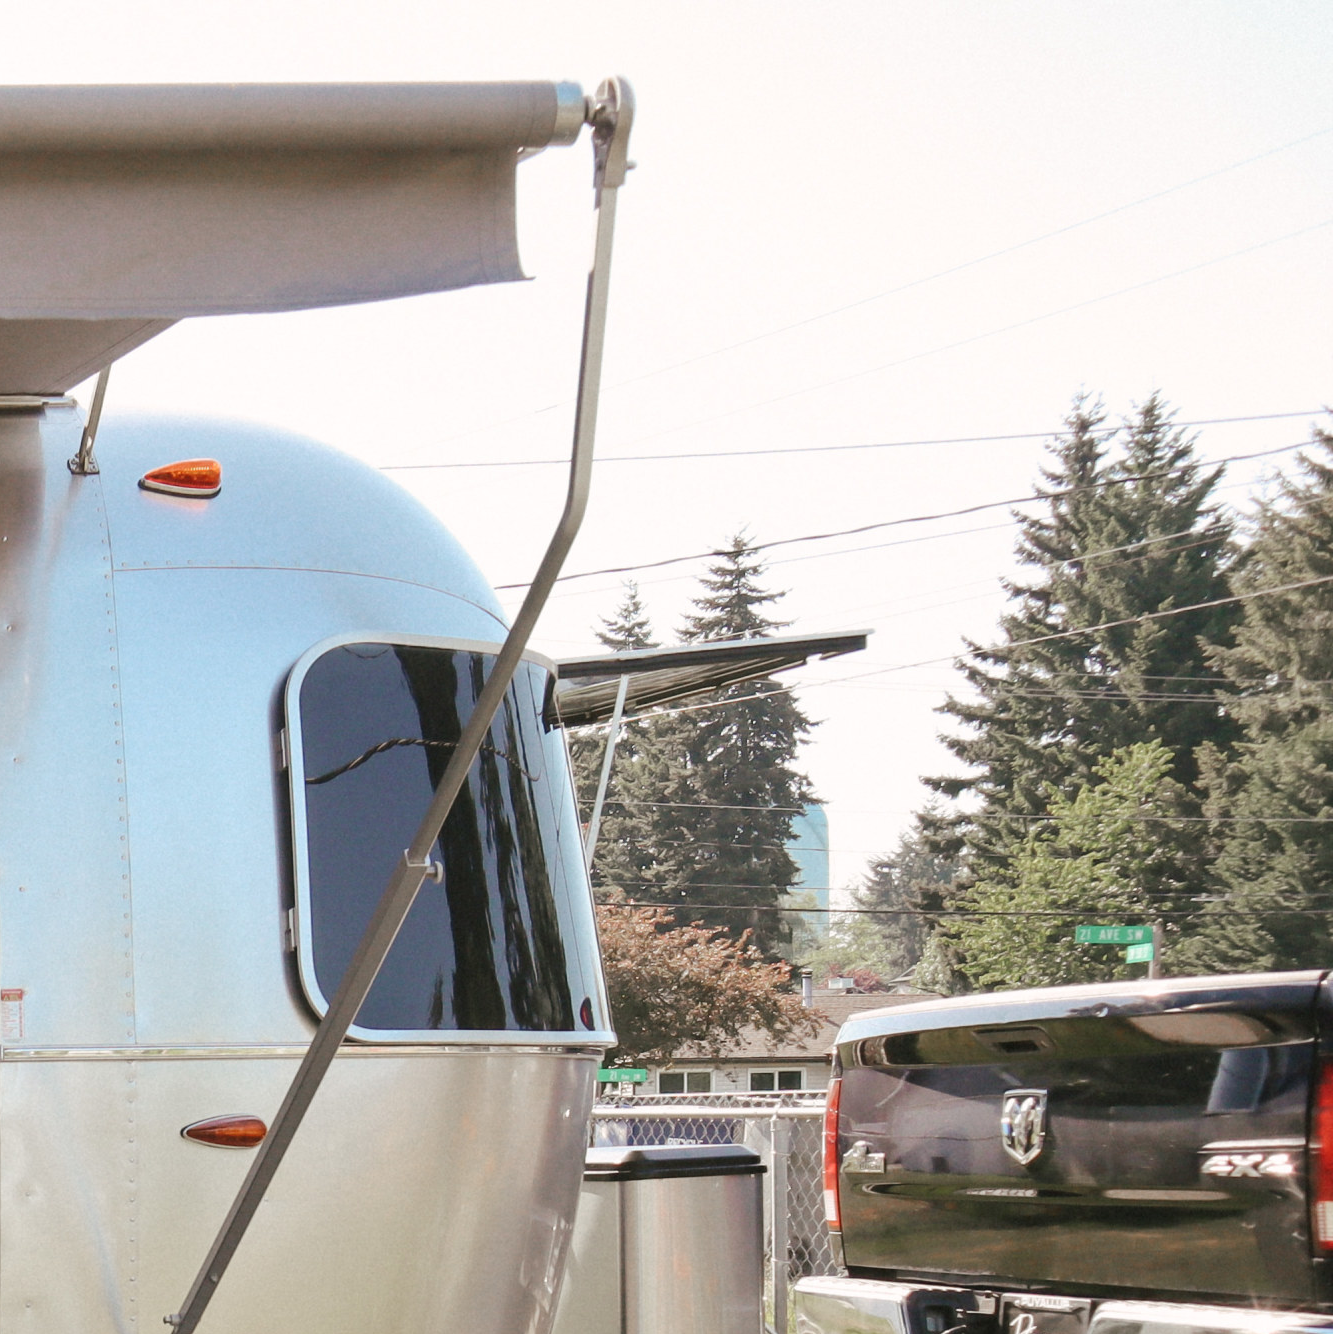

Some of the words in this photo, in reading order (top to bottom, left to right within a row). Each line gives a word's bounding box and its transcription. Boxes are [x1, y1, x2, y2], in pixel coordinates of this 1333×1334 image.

[1080, 929, 1092, 941] 21
[1098, 929, 1121, 941] AVE
[1126, 929, 1145, 941] SW
